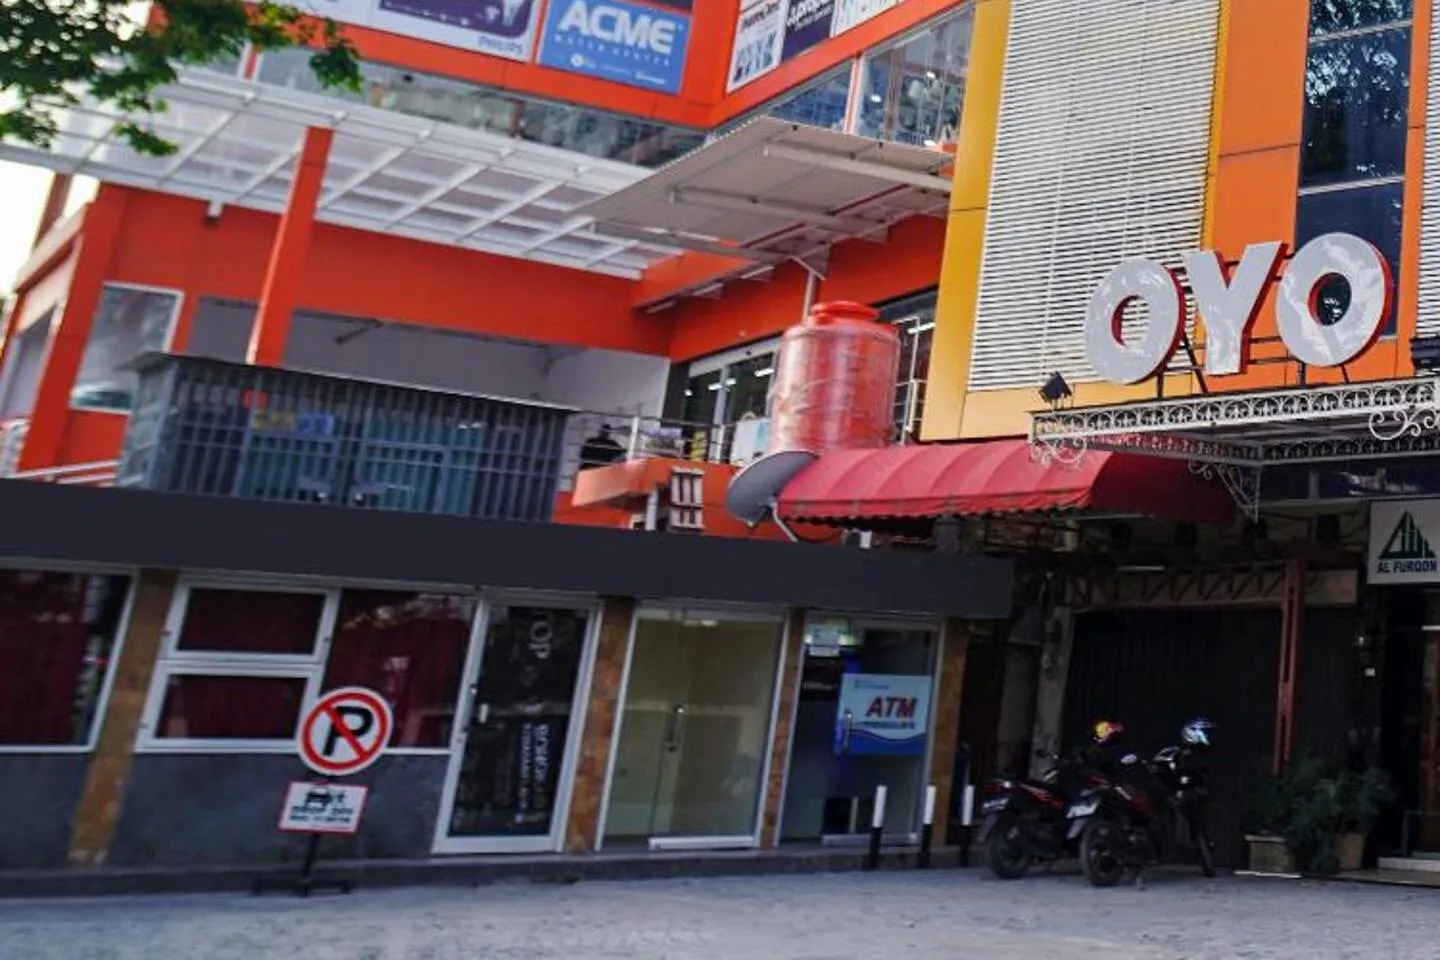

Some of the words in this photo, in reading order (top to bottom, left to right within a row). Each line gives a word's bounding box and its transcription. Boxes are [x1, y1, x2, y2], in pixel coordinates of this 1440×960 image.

[1083, 231, 1394, 385] OYO
[1377, 561, 1391, 574] AL
[1393, 560, 1438, 573] FURQON
[865, 696, 919, 718] ATM
[323, 706, 374, 756] P
